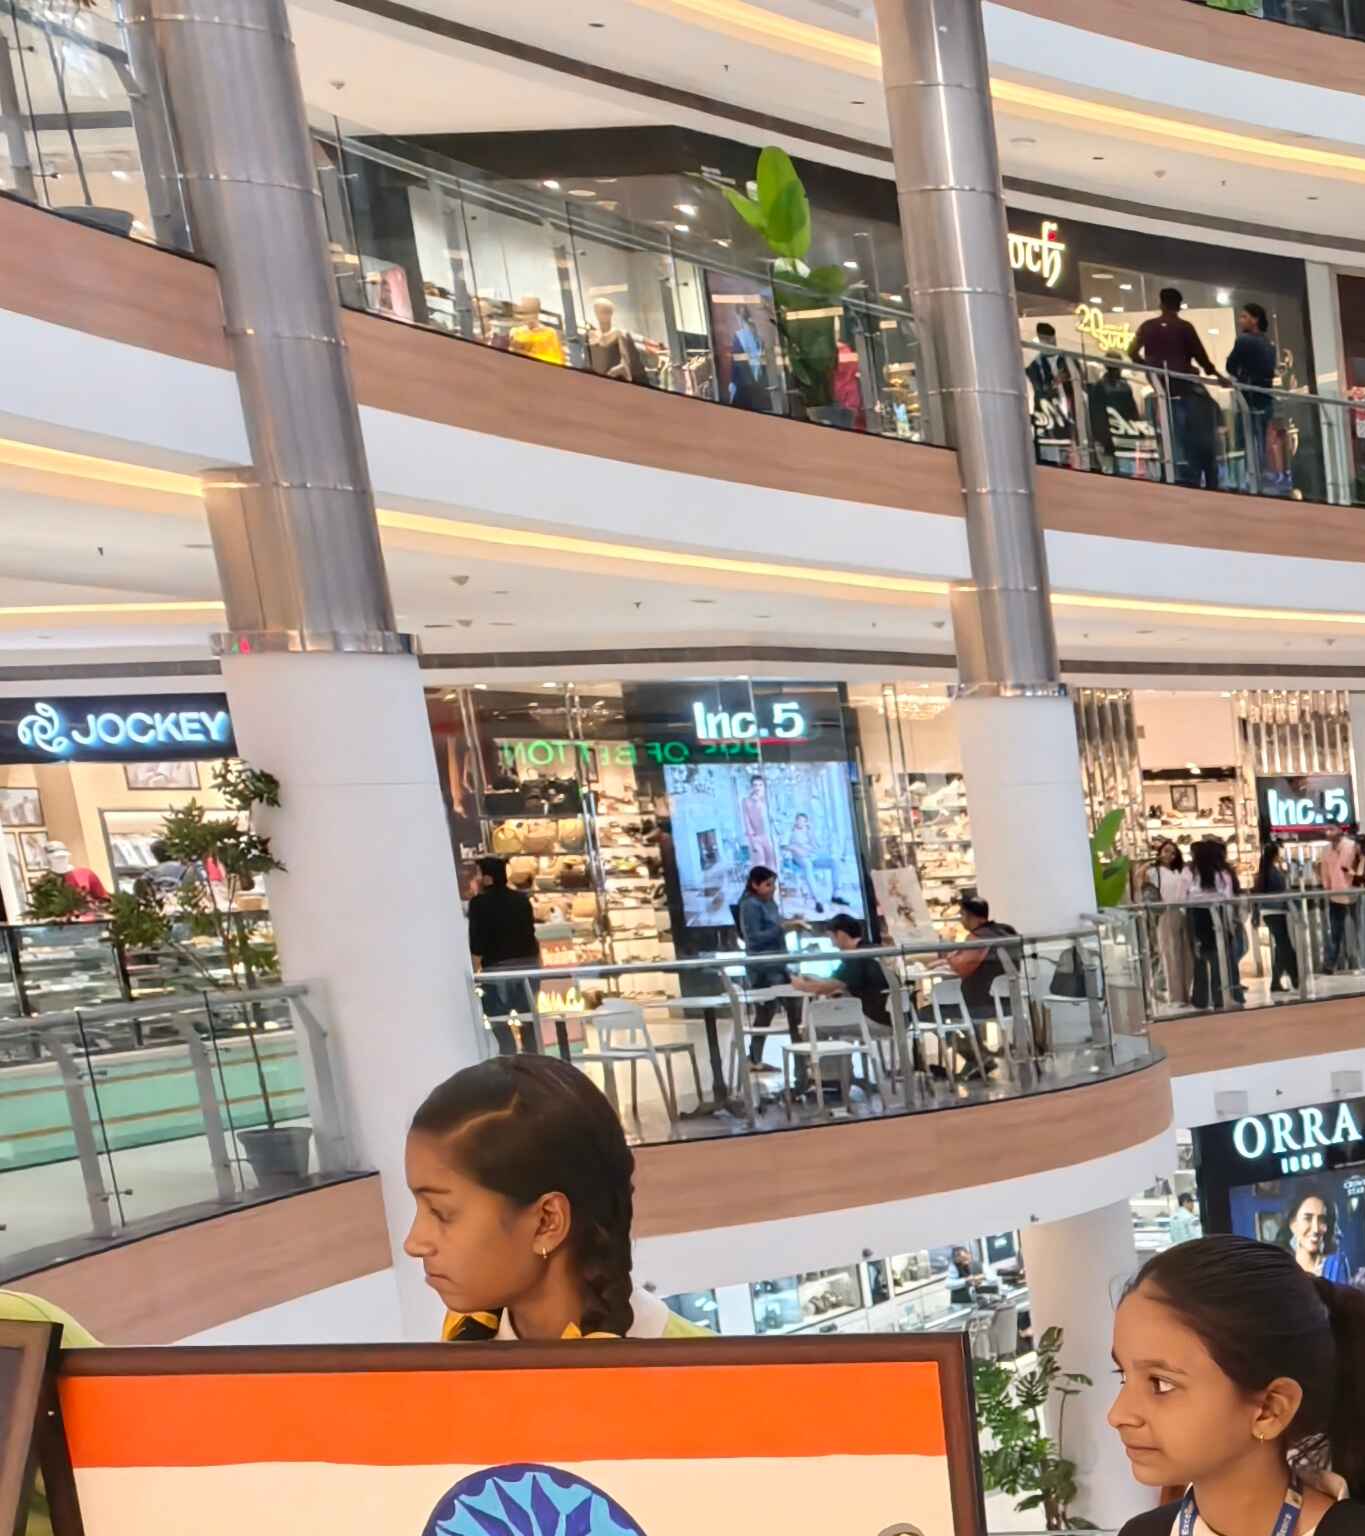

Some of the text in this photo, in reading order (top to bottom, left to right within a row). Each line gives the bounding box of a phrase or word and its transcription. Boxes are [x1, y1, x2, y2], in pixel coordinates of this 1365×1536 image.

[1008, 221, 1066, 287] och
[71, 711, 231, 746] JOCKEY
[1233, 1102, 1363, 1159] ORRA
